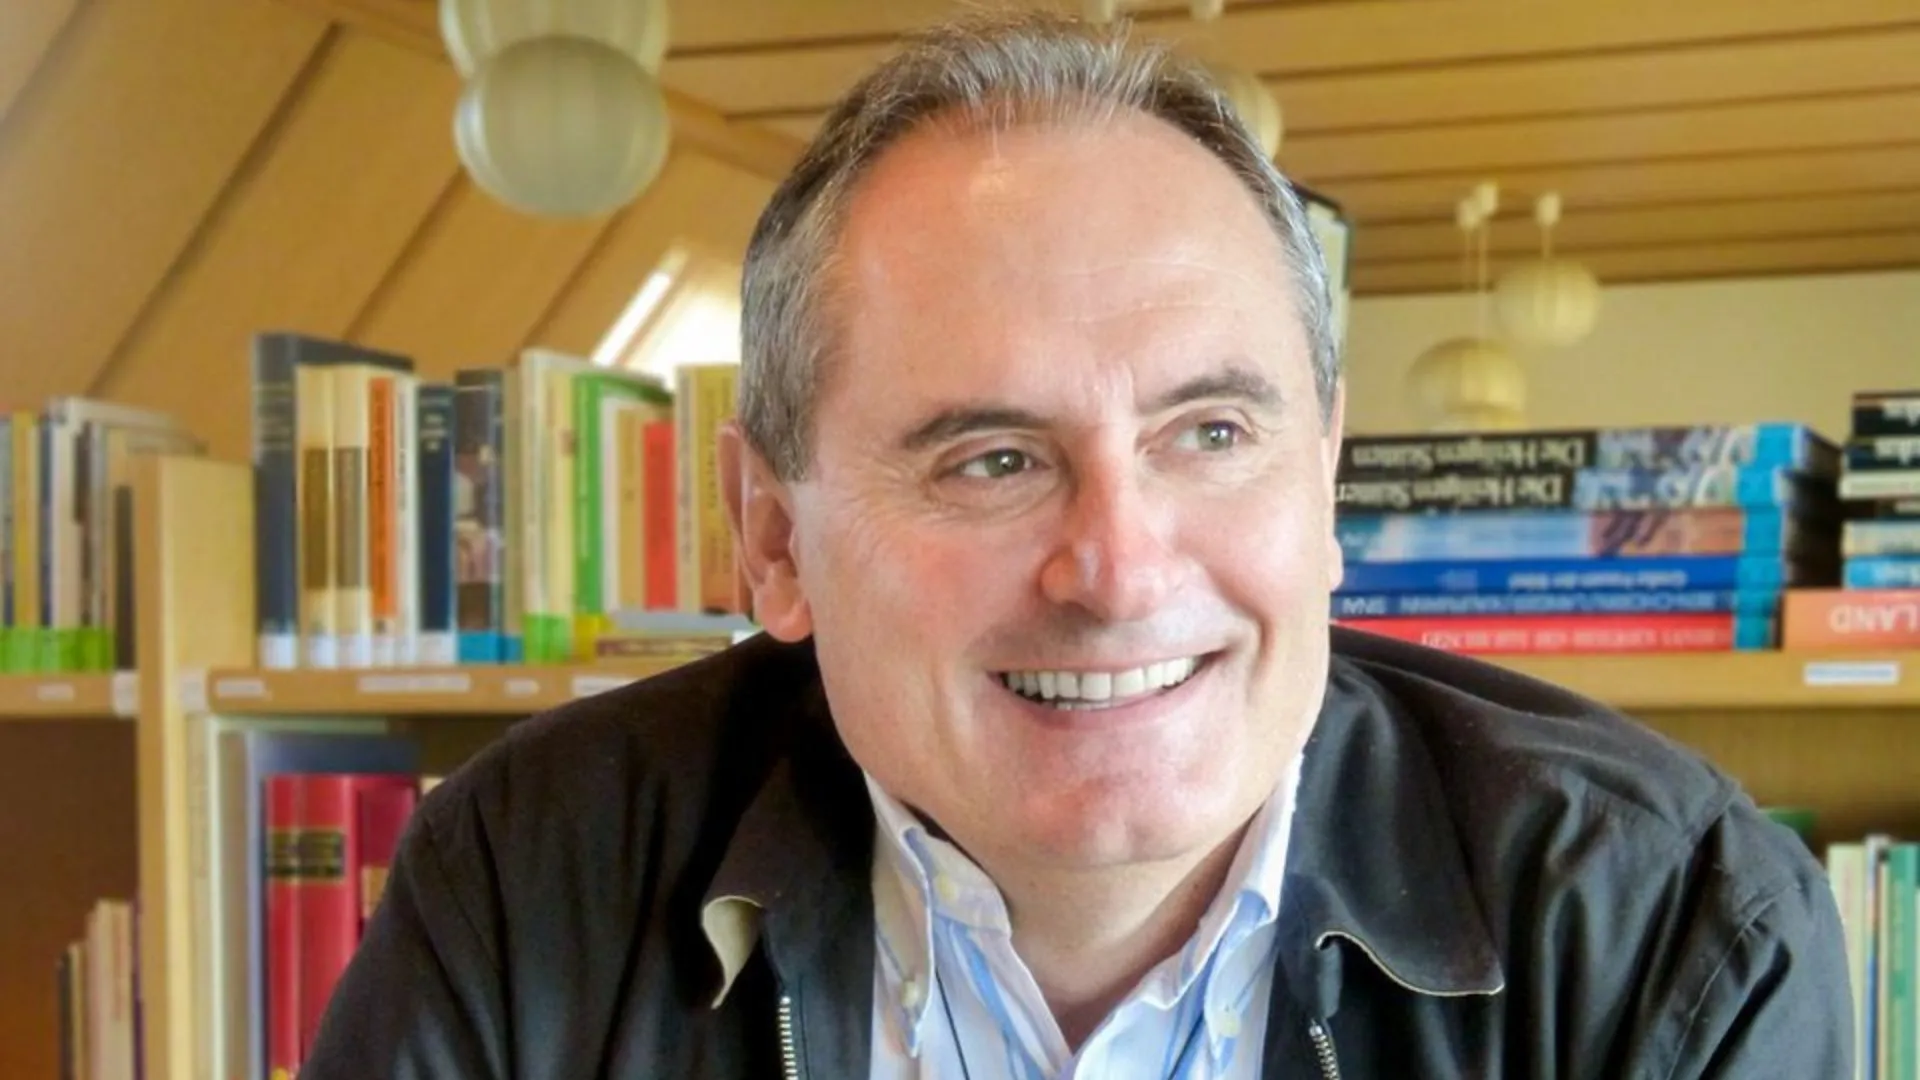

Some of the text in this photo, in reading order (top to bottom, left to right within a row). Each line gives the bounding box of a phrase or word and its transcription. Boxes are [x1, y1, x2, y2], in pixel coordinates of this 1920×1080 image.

[1436, 438, 1537, 469] Heiligen
[1539, 438, 1585, 467] Die
[1413, 473, 1515, 506] Heiligen
[1517, 473, 1562, 503] Die
[1827, 603, 1918, 635] LAND
